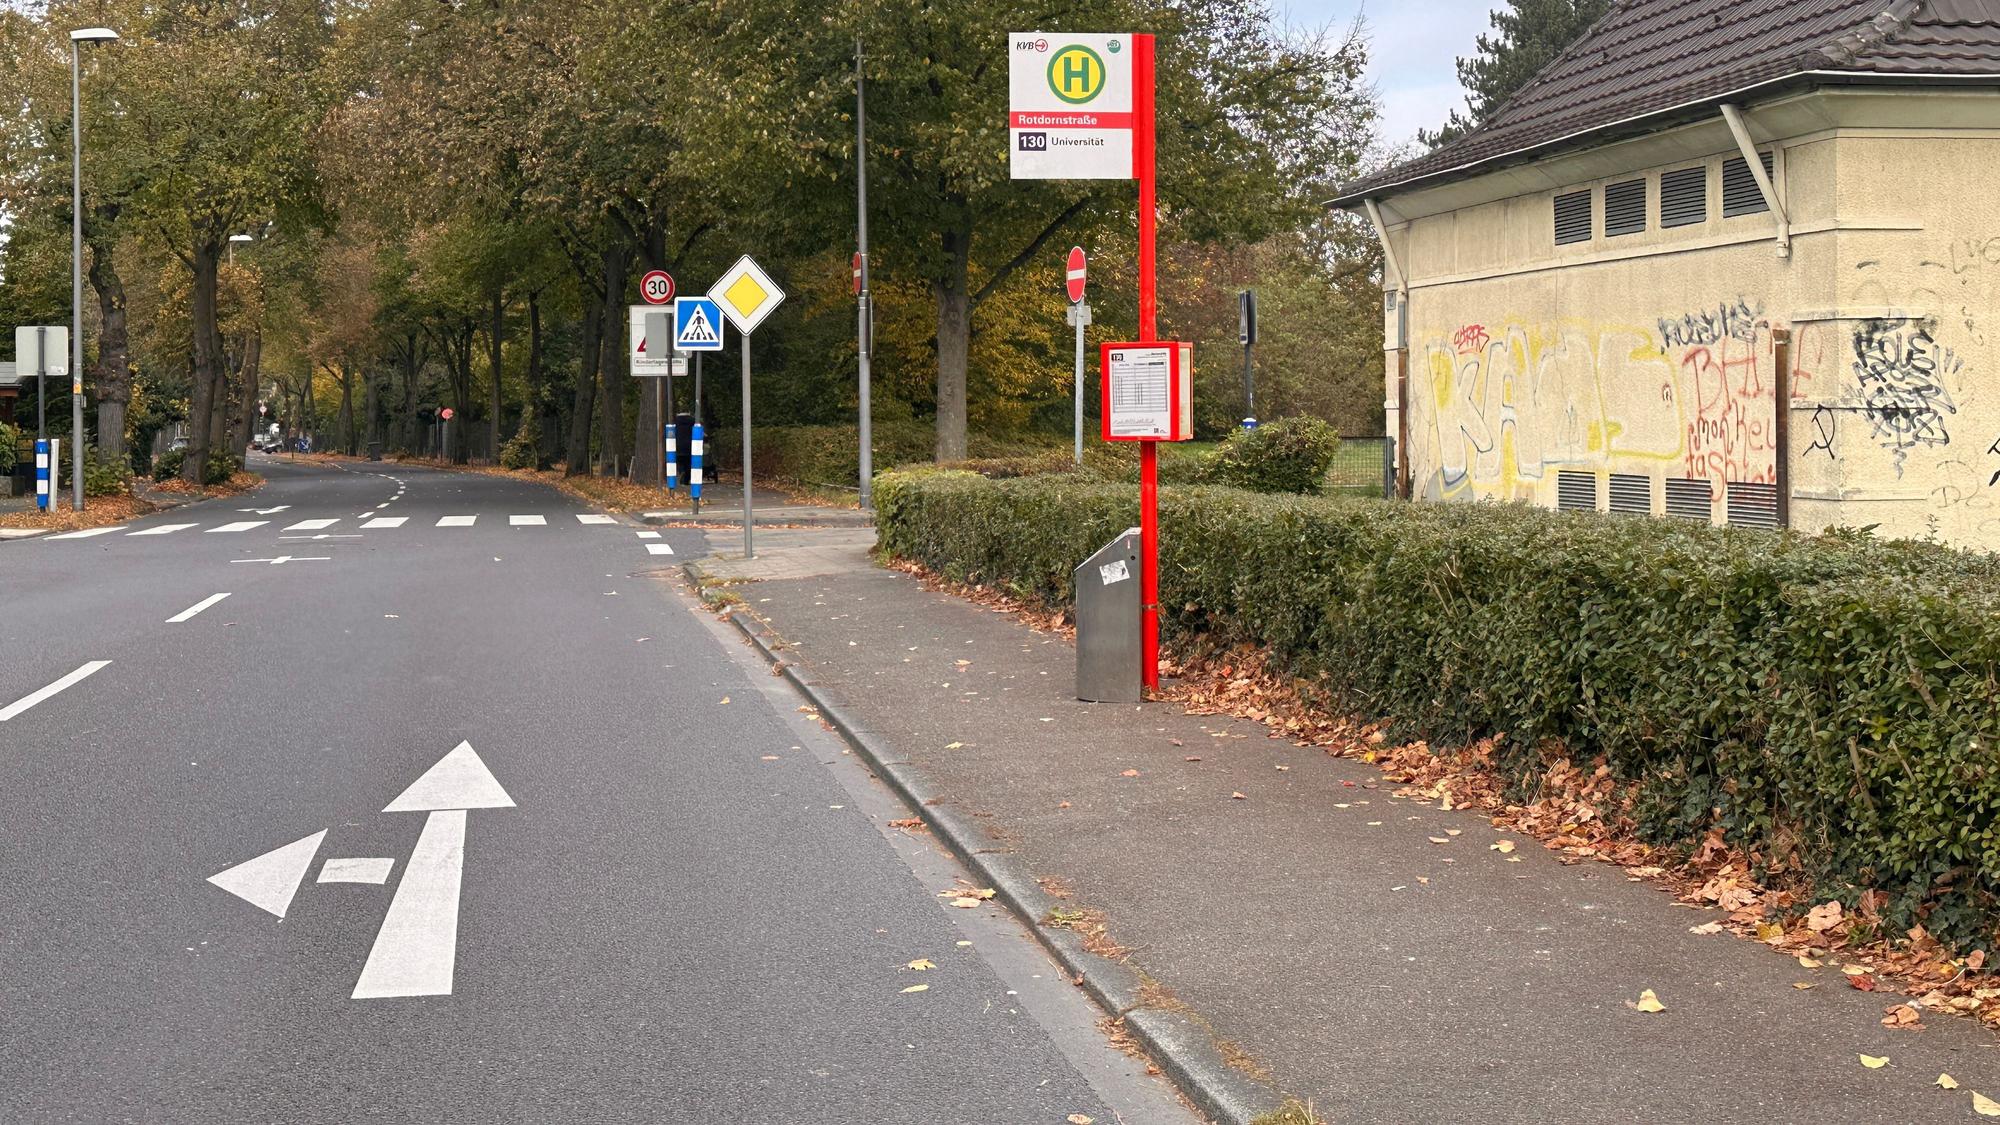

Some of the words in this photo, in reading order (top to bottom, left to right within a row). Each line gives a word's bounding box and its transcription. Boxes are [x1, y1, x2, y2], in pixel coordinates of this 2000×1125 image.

[1016, 41, 1034, 50] KVB
[1063, 56, 1090, 93] H
[1018, 114, 1097, 125] Rotdornstraße
[1020, 136, 1045, 148] 130
[1051, 137, 1104, 146] Universität
[648, 280, 667, 295] 30
